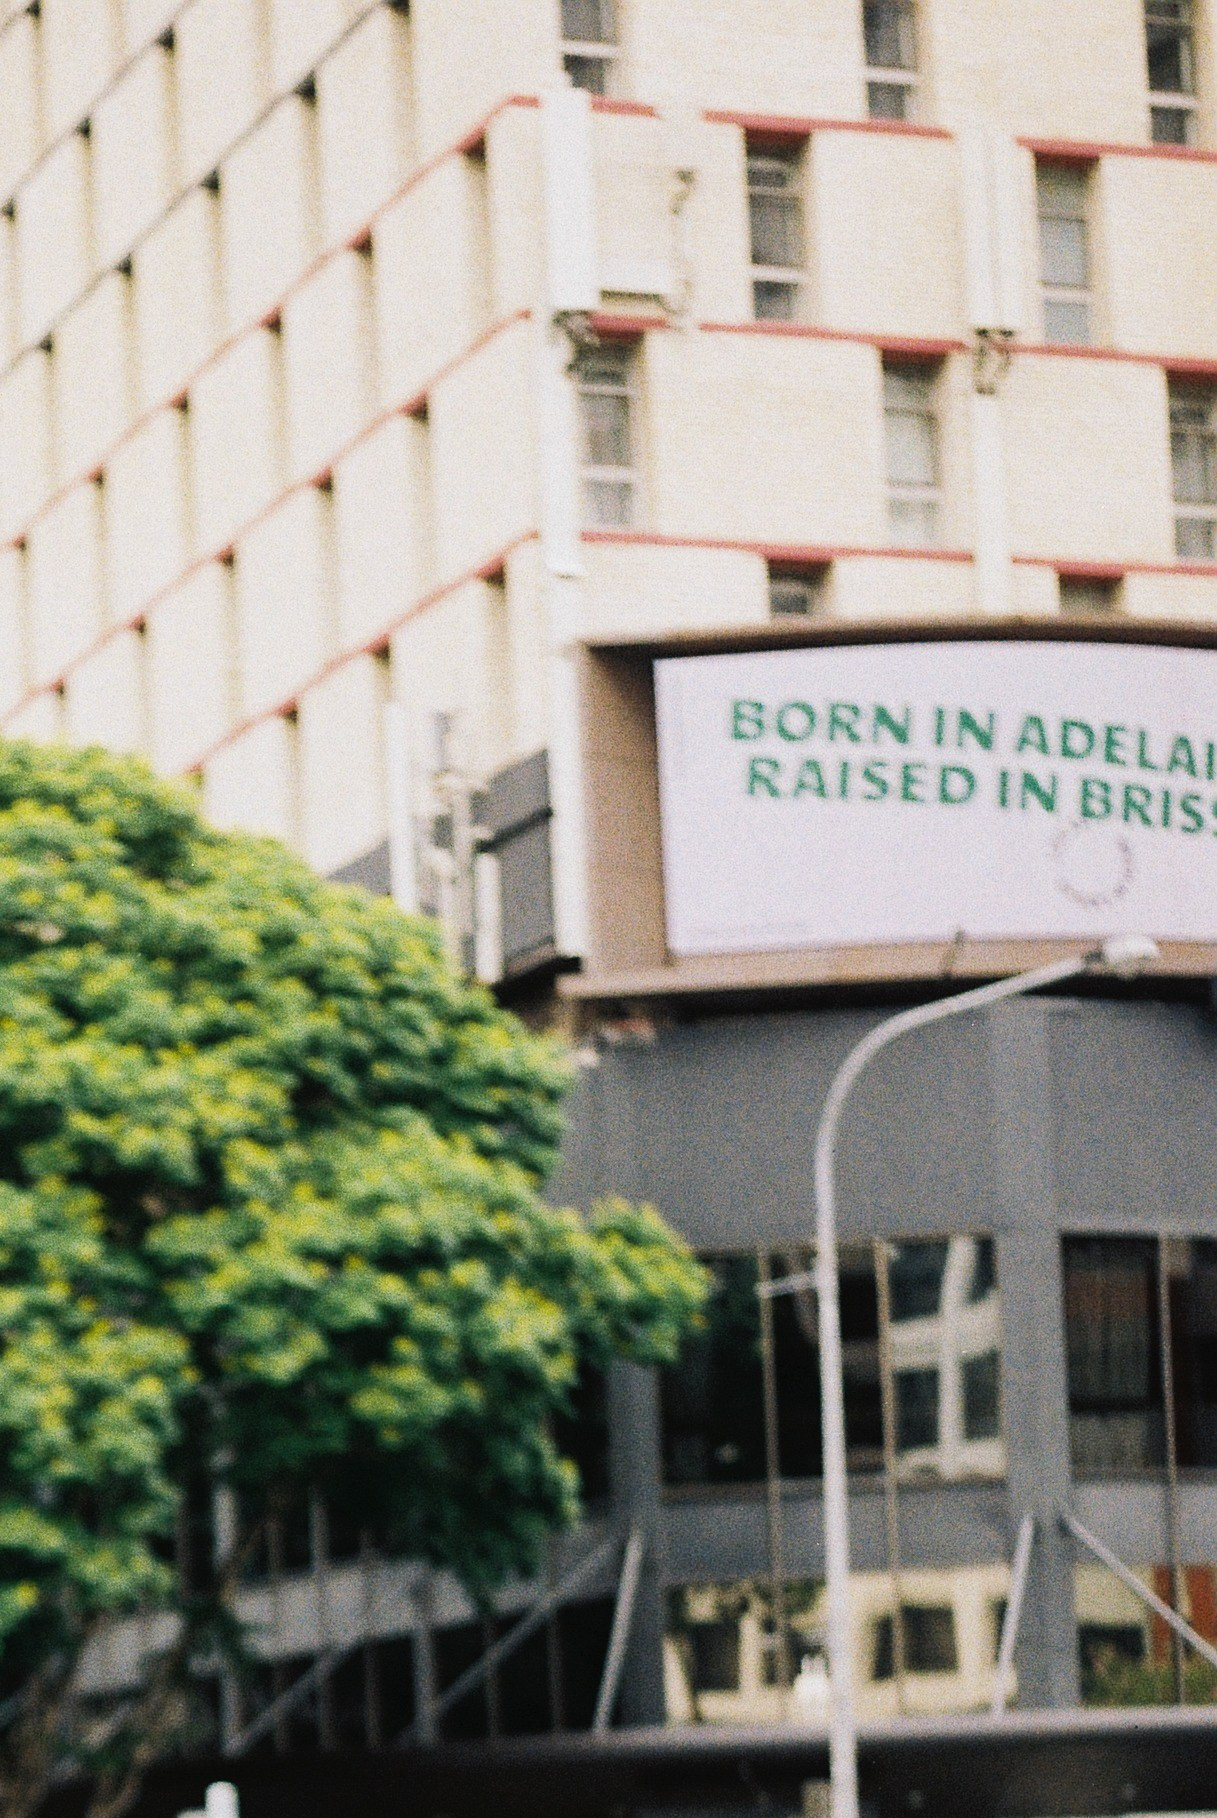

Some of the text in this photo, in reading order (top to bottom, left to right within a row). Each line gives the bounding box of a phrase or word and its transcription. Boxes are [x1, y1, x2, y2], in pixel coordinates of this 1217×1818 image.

[731, 699, 910, 745] BORN
[933, 705, 995, 752] IN
[747, 756, 1217, 837] RAISED IN BRIS
